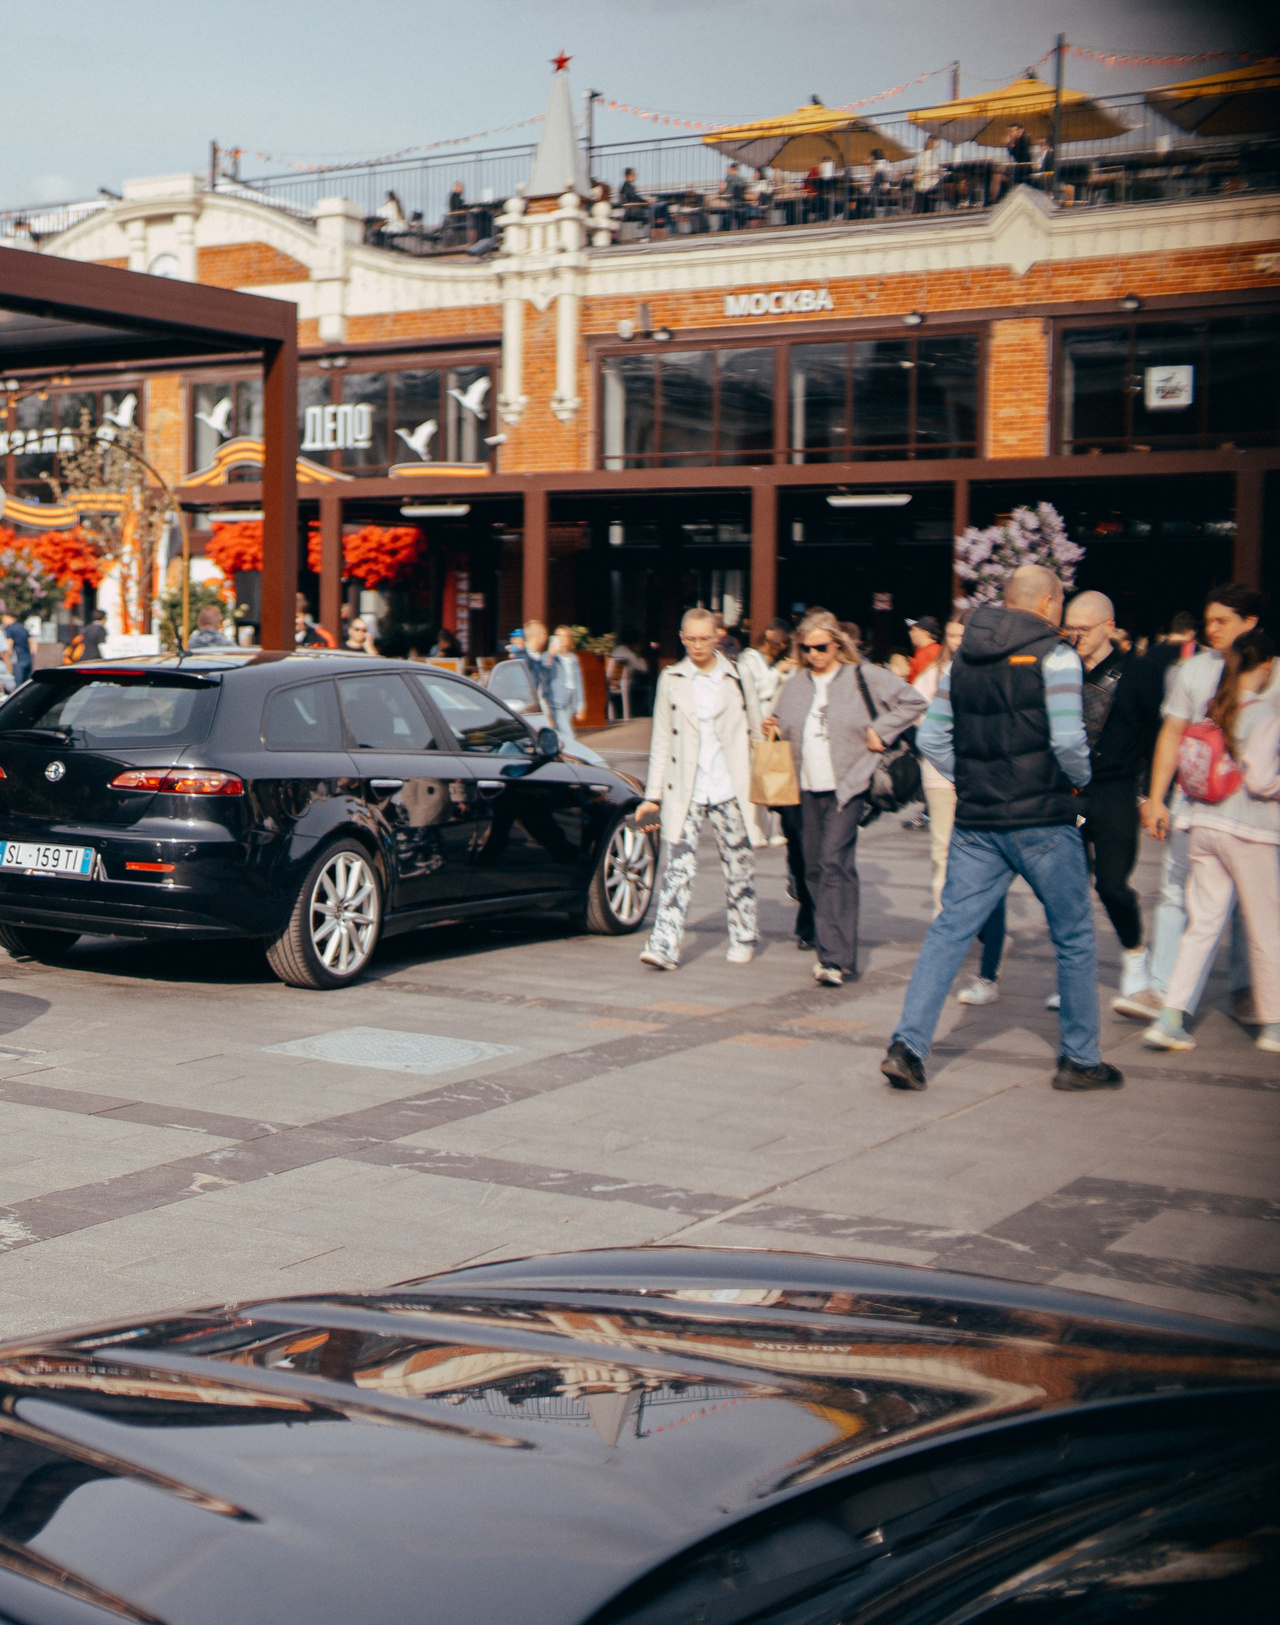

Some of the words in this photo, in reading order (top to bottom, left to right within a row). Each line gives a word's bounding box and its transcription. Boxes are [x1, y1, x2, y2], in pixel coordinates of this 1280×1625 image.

[724, 289, 834, 317] МОСКВА
[300, 402, 373, 451] ДЕПО
[64, 849, 79, 870] TI
